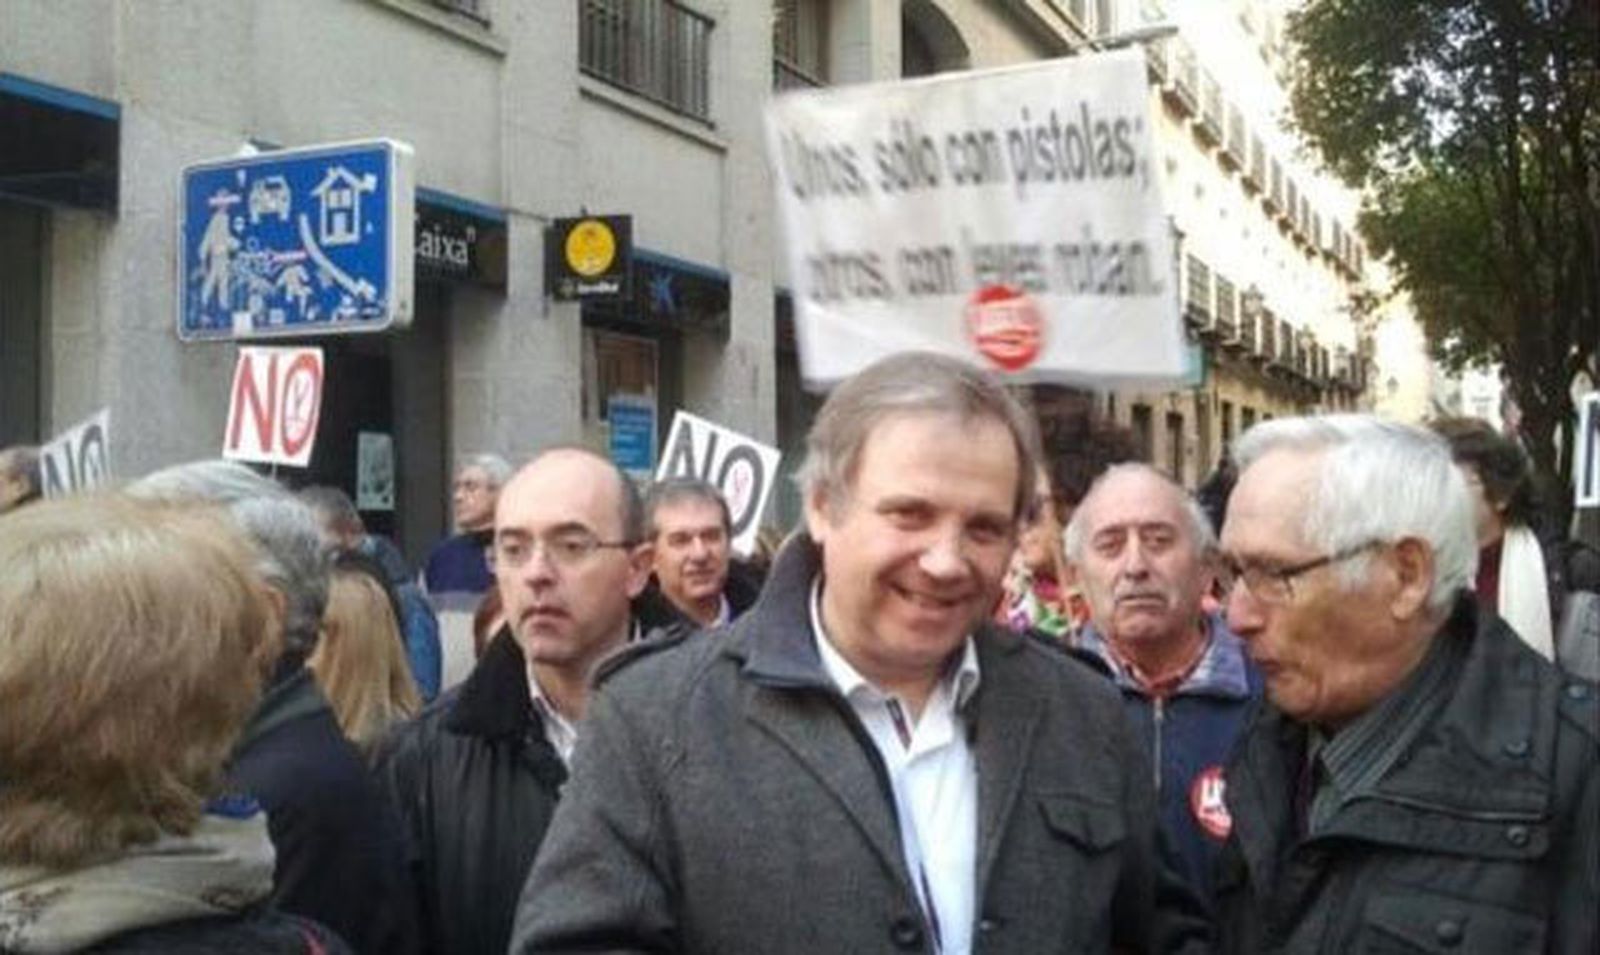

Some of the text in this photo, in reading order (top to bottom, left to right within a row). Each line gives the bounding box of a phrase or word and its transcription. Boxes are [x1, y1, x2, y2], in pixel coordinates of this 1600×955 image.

[945, 126, 1001, 186] con
[230, 352, 321, 457] NO
[43, 424, 104, 498] NO
[665, 419, 765, 538] NO
